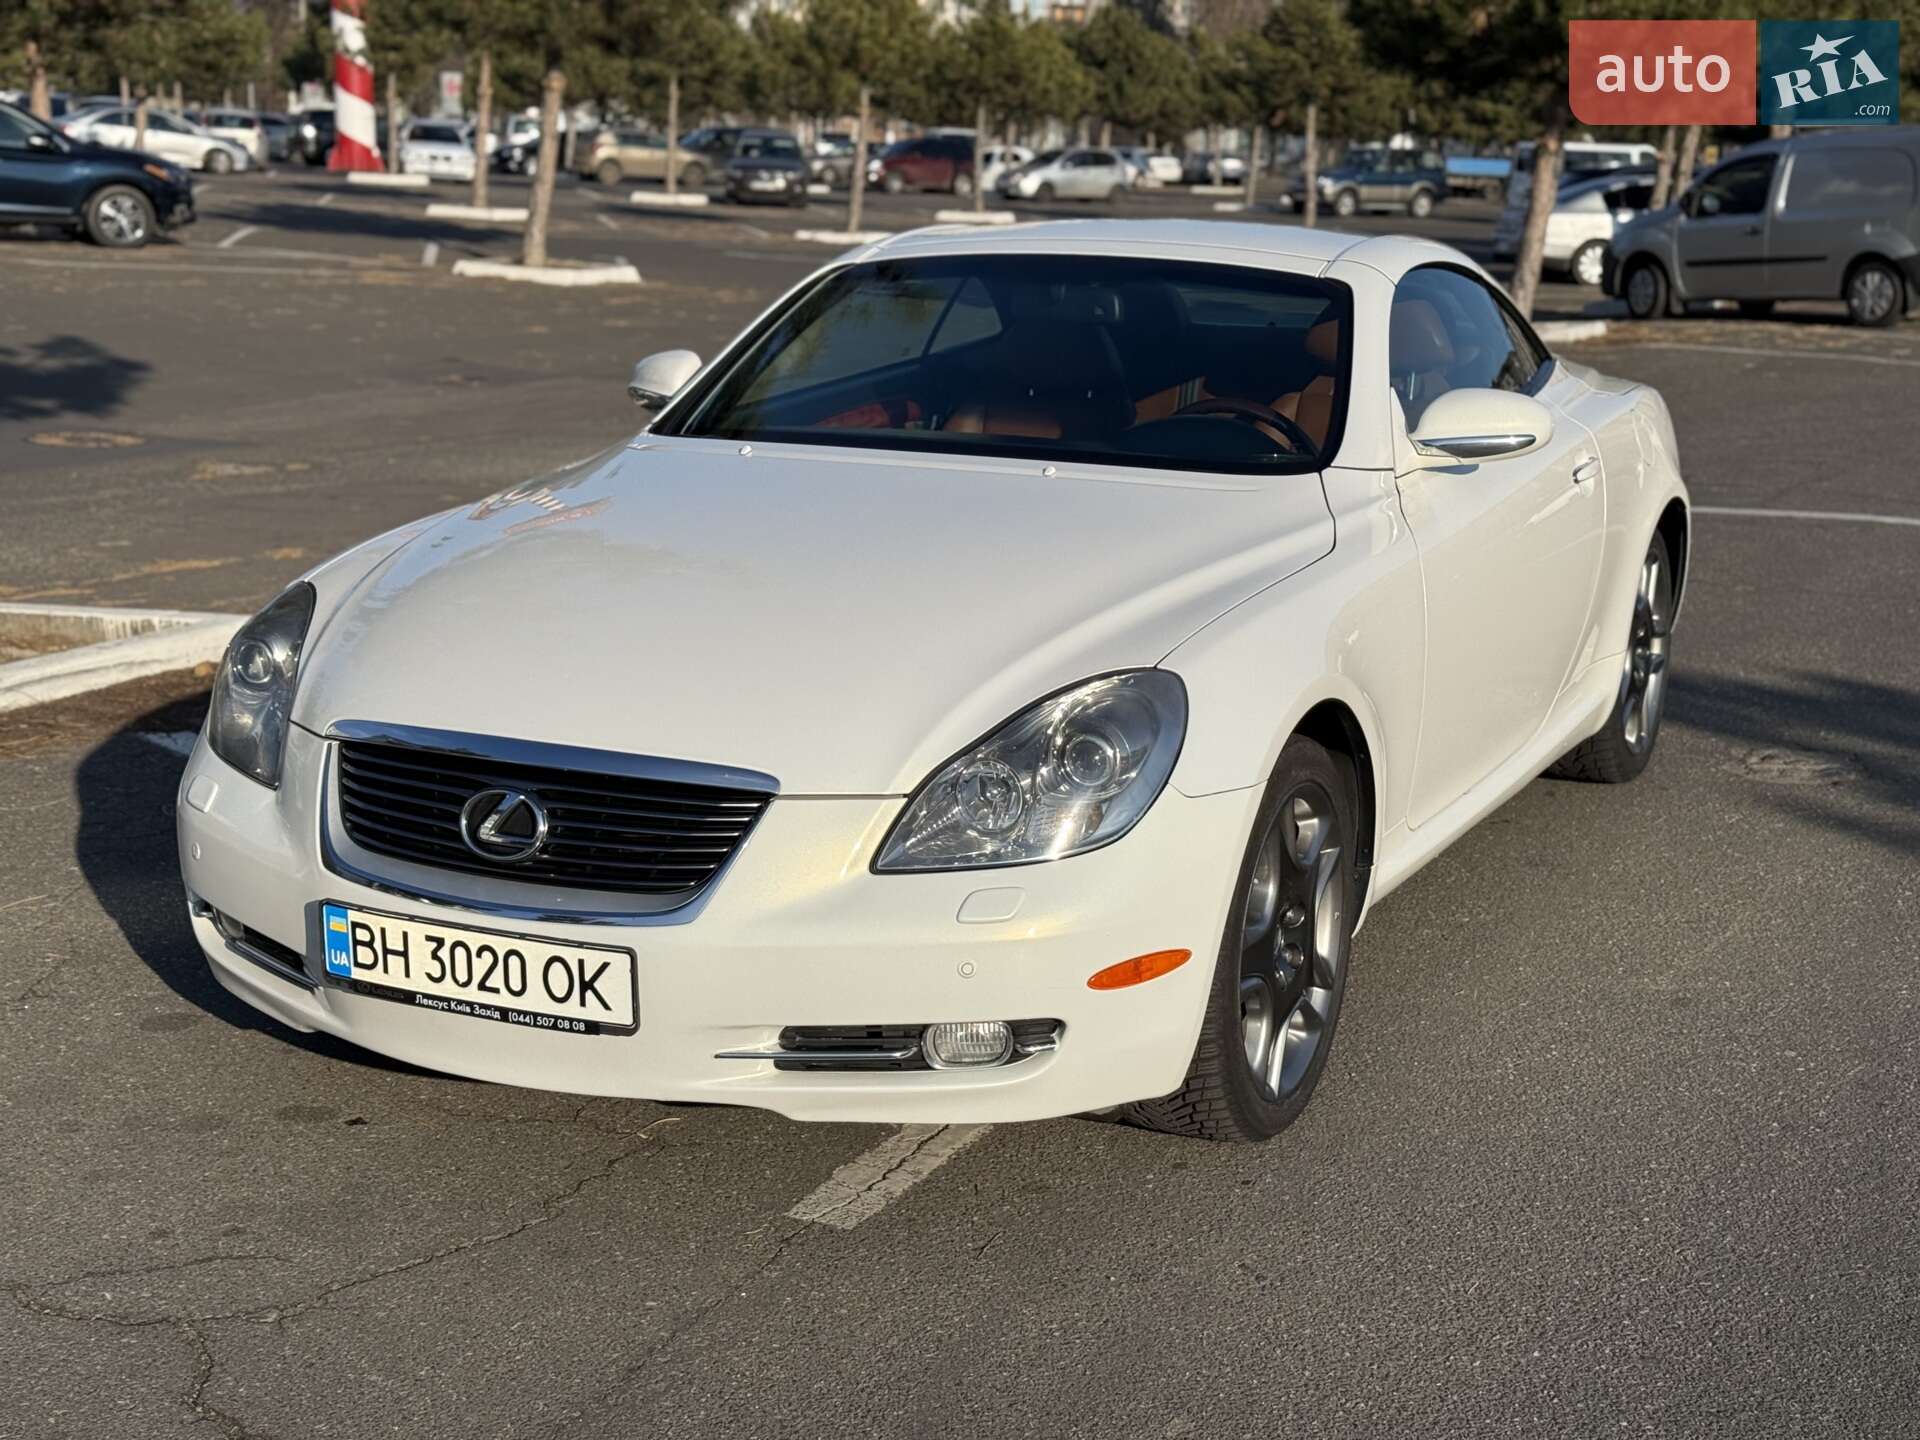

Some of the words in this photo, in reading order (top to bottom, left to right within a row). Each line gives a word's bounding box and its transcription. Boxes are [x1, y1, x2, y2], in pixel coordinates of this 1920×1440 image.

[331, 949, 350, 967] UA
[350, 920, 411, 979] BH
[424, 934, 528, 998] 3020
[542, 955, 613, 1012] OK
[415, 994, 449, 1010] Лексус
[450, 1001, 471, 1013] Київ
[473, 1004, 501, 1020] Захід
[508, 1011, 534, 1026] (044)
[536, 1014, 555, 1027] 507
[557, 1018, 570, 1030] 08
[572, 1020, 586, 1032] 08
